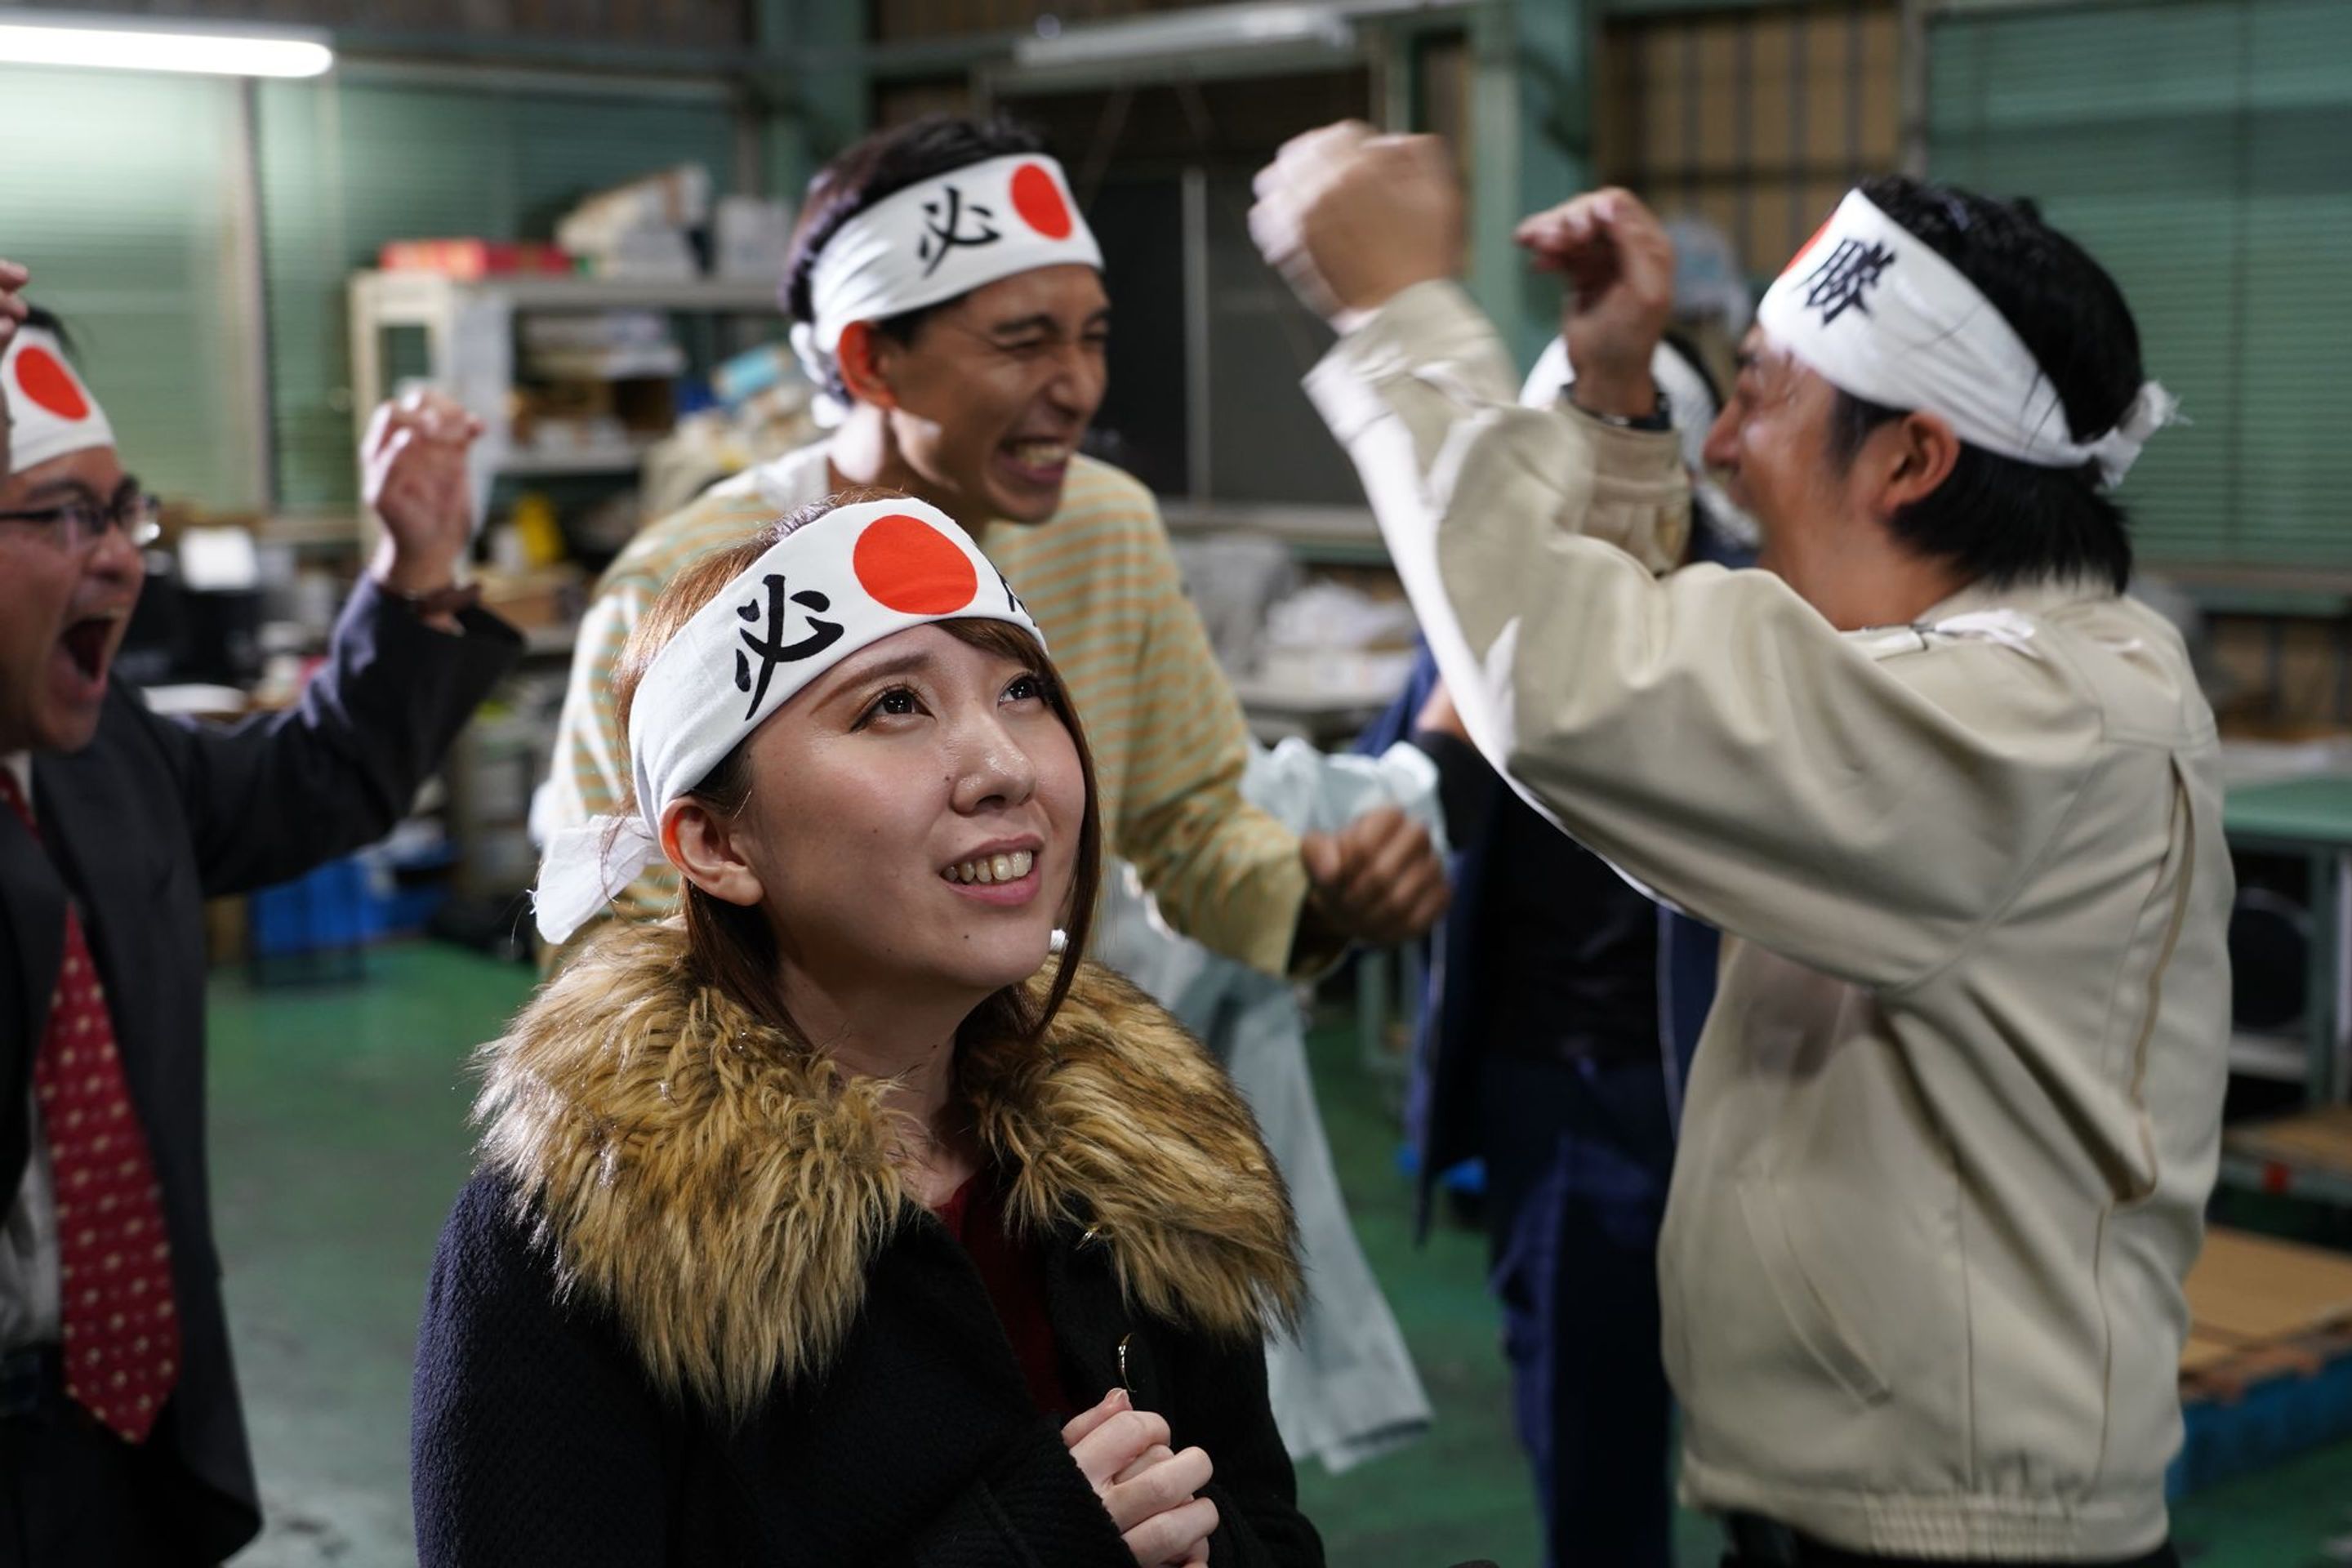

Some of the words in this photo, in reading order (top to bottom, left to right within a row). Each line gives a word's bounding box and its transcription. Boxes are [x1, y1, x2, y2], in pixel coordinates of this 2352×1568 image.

[918, 186, 1001, 277] 必
[1793, 238, 1896, 327] 勝
[734, 574, 844, 721] 必
